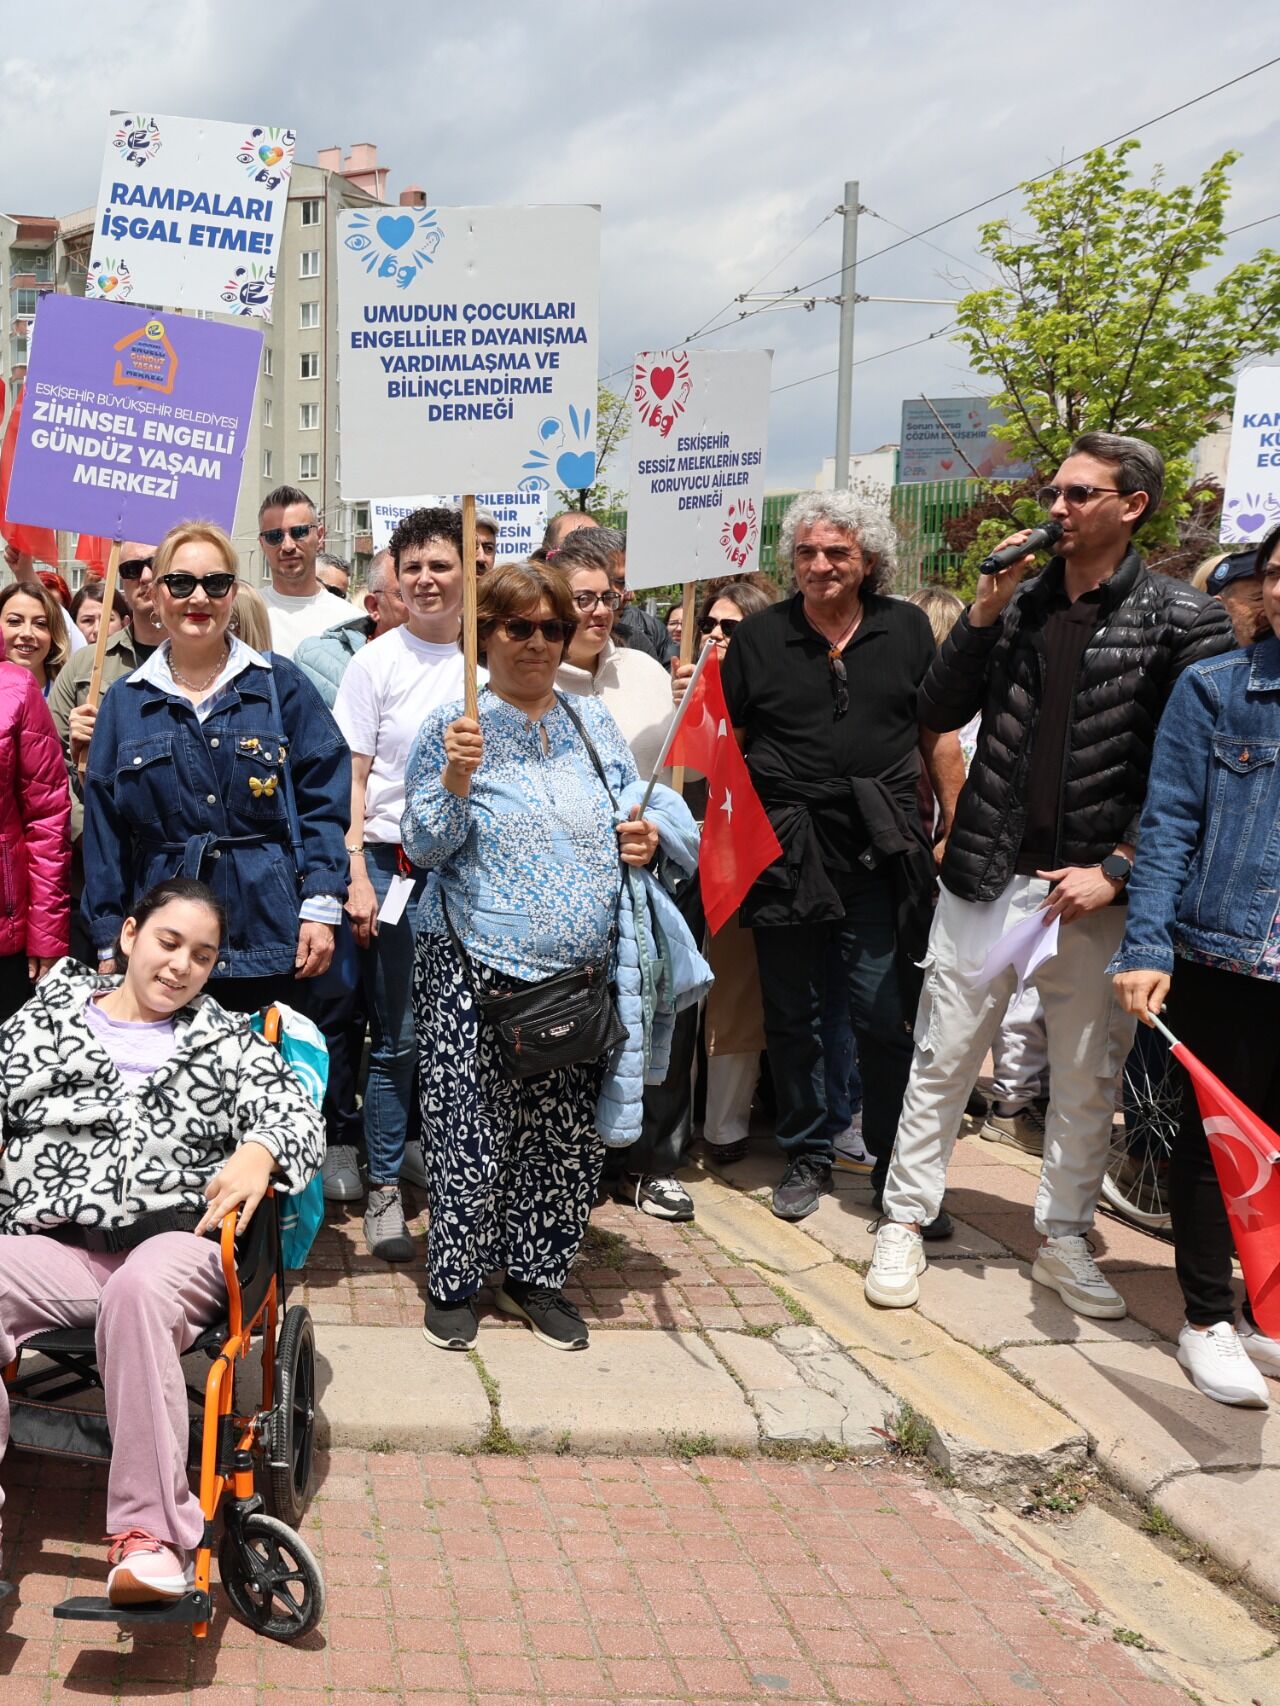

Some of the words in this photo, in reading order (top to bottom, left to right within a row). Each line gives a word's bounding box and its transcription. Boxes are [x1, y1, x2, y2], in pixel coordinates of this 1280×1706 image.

[110, 182, 273, 223] RAMPALARI
[101, 207, 183, 244] İŞGAL
[188, 223, 273, 256] ETME!
[363, 303, 458, 324] UMUDUN
[462, 302, 576, 324] ÇOCUKLARI
[350, 325, 466, 349] ENGELLİLER
[471, 326, 588, 348] DAYANIŞMA
[380, 353, 533, 375] YARDIMLAŞMA
[535, 351, 560, 370] VE
[387, 373, 553, 400] BİLİNÇLENDİRME
[35, 382, 95, 402] ESKİŞEHİR
[97, 392, 171, 417] BÜYÜKŞEHİR
[174, 407, 238, 430] BELEDİYESİ
[428, 397, 514, 422] DERNEĞİ
[32, 398, 138, 438] ZİHİNSEL
[142, 419, 236, 455] ENGELLİ
[31, 426, 134, 464] GÜNDÜZ
[138, 447, 221, 480] YAŞAM
[677, 432, 730, 452] ESKİŞEHİR
[638, 454, 675, 475] SESSİZ
[677, 450, 739, 472] MELEKLERİN
[741, 448, 762, 466] SESİ
[72, 463, 179, 500] MERKEZİ
[651, 474, 710, 494] KORUYUCU
[712, 470, 749, 488] AİLELER
[678, 489, 722, 511] DERNEĞİ
